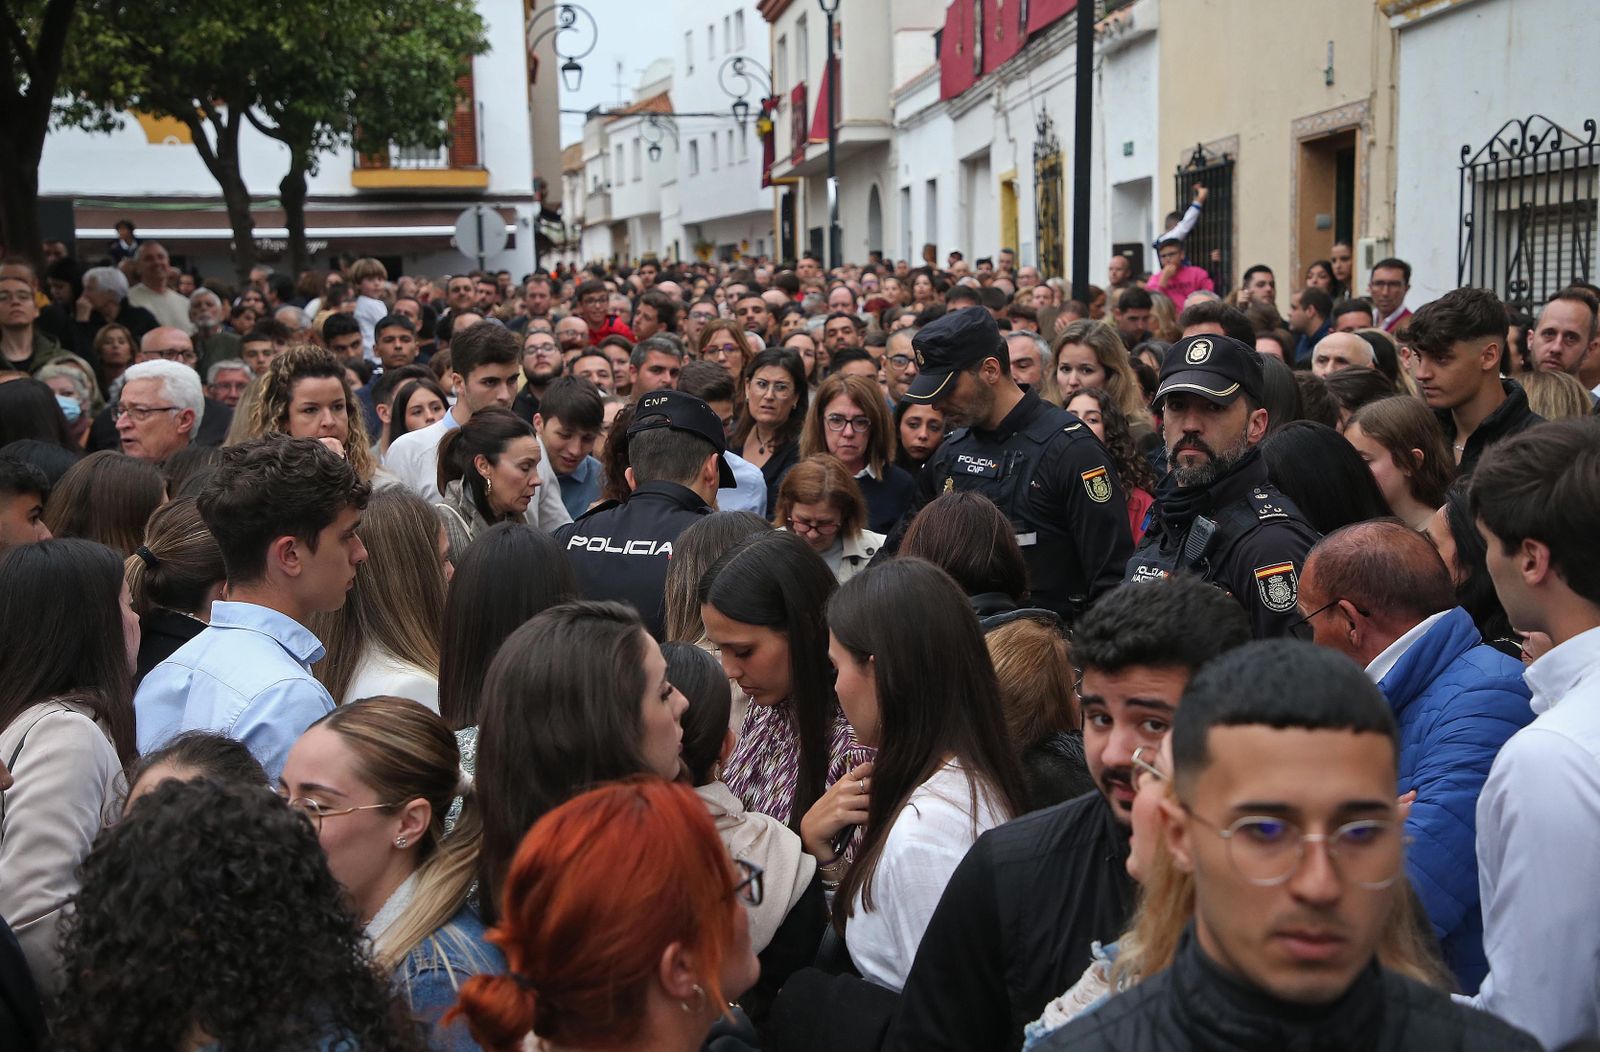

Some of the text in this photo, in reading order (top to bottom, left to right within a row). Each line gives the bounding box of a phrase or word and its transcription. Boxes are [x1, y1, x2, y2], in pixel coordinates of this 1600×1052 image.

[644, 396, 668, 407] CNP
[957, 455, 993, 467] POLICIA
[967, 465, 985, 474] CNP
[566, 535, 673, 555] POLICIA
